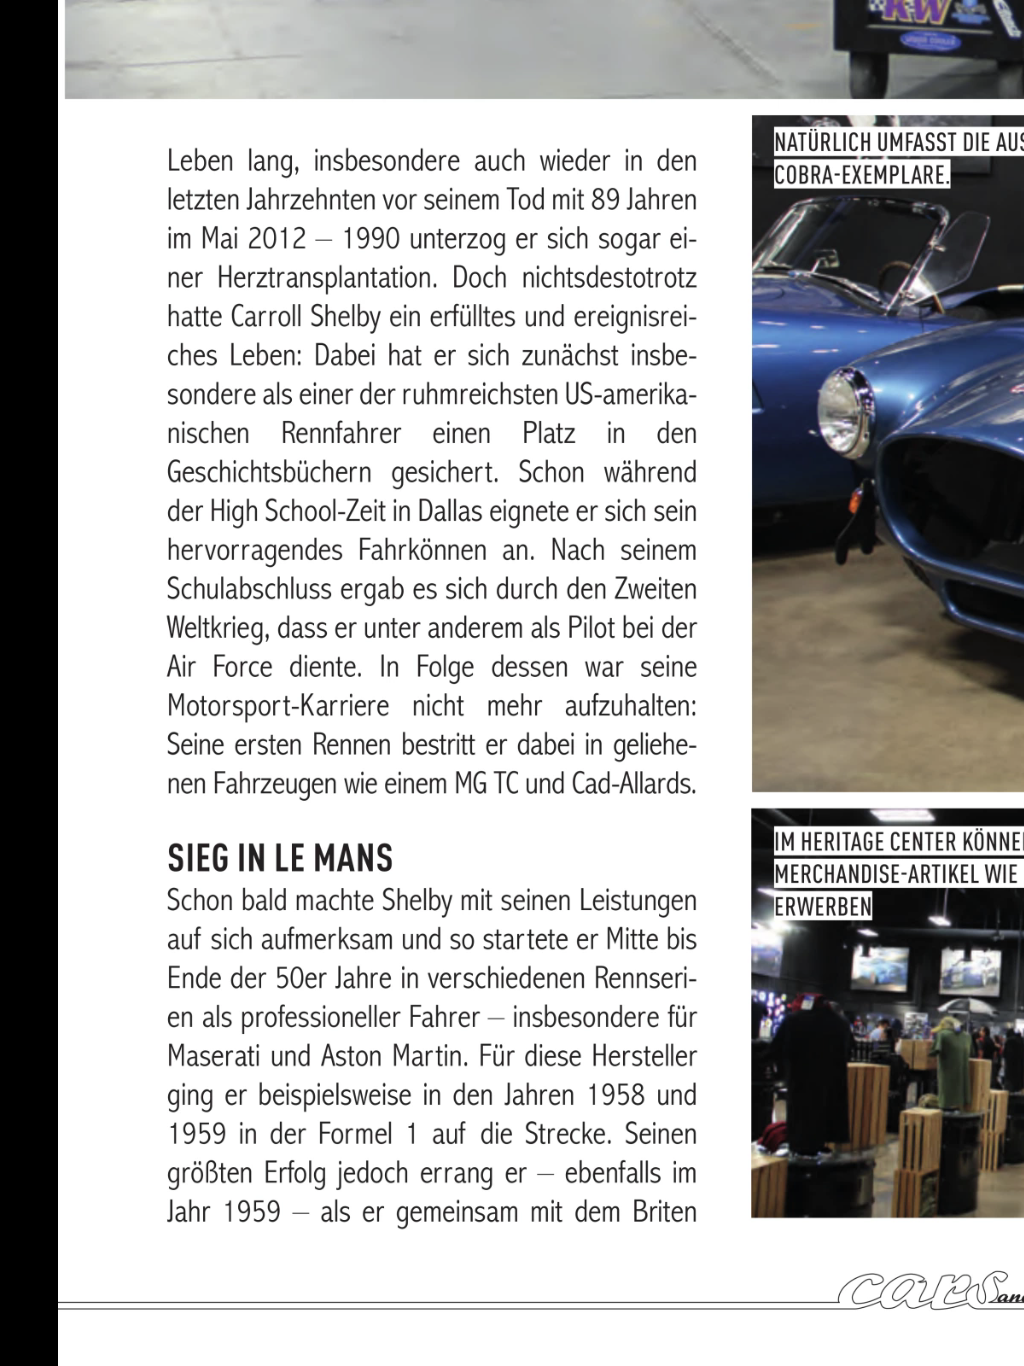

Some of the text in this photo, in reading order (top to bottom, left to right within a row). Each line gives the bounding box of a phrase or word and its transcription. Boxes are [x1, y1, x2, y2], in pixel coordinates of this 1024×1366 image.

[169, 148, 696, 178] Leben lang, insbesondere auch wieder in den
[169, 187, 696, 210] letzten Jahrzehnten vor seinem Tod mit 89 Jahren
[169, 265, 697, 294] ner Herztransplantation. Doch nichtsdestotrotz
[169, 304, 696, 334] hatte Carroll Shelby ein erfülltes und ereignisrei-
[169, 421, 696, 443] nischen Rennfahrer einen Platz in den
[168, 459, 696, 489] Geschichtsbüchern gesichert. Schon während
[169, 538, 696, 567] hervorragendes Fahrkönnen an. Nach seinem
[167, 654, 696, 684] Air Force diente. In Folge dessen war seine
[169, 693, 695, 722] Motorsport-Karriere nicht mehr aufzuhalten:
[169, 771, 695, 801] nen Fahrzeugen wie einem MG TC und Cad-Allards.
[169, 843, 392, 872] SIEG IN LE MANS
[168, 888, 696, 918] Schon bald machte Shelby mit seinen Leistungen
[169, 1044, 697, 1066] Maserati und Aston Martin. Für diese Hersteller
[838, 1271, 1008, 1310] cars
